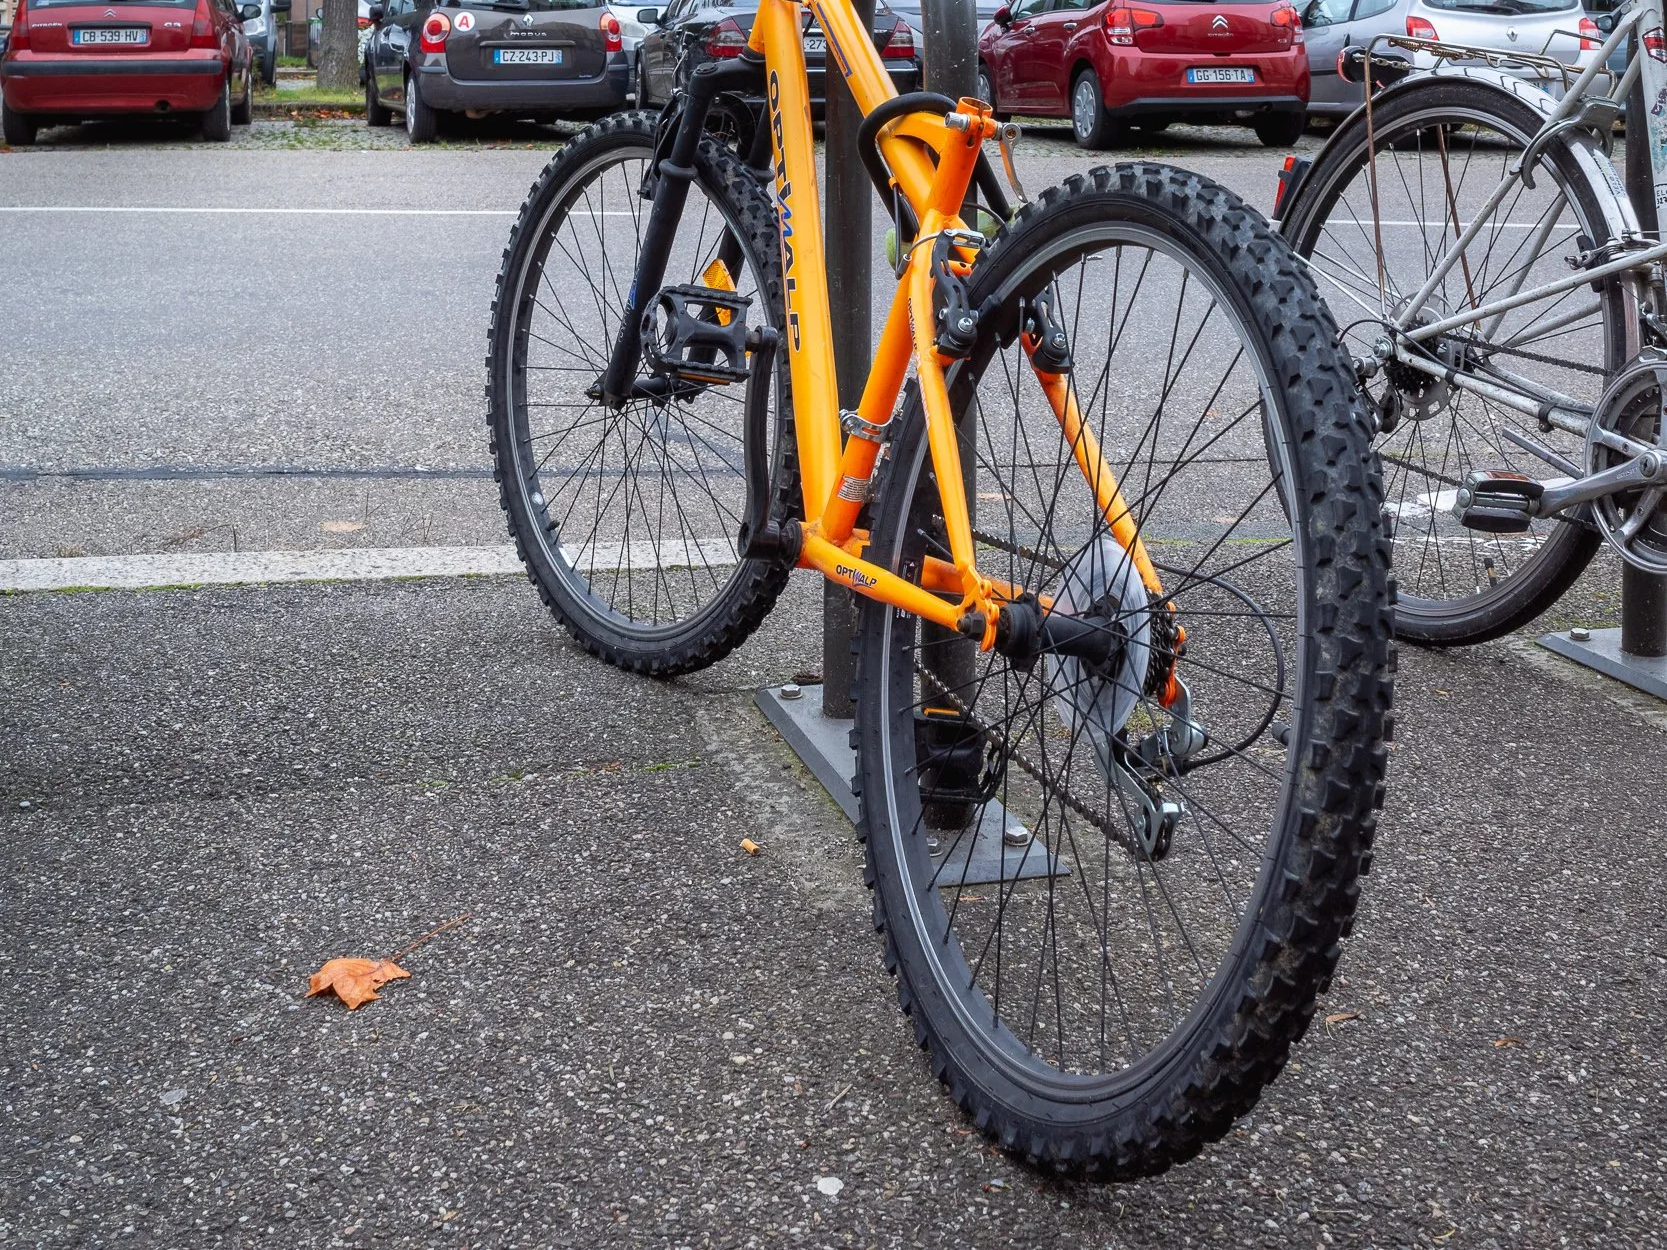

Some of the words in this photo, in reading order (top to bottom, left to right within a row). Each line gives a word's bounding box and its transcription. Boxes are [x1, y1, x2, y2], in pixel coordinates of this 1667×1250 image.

[458, 15, 469, 28] A
[82, 31, 139, 43] CB-539-HV
[502, 50, 555, 62] CZ-243-PJ
[1195, 69, 1247, 81] GG-156-TA
